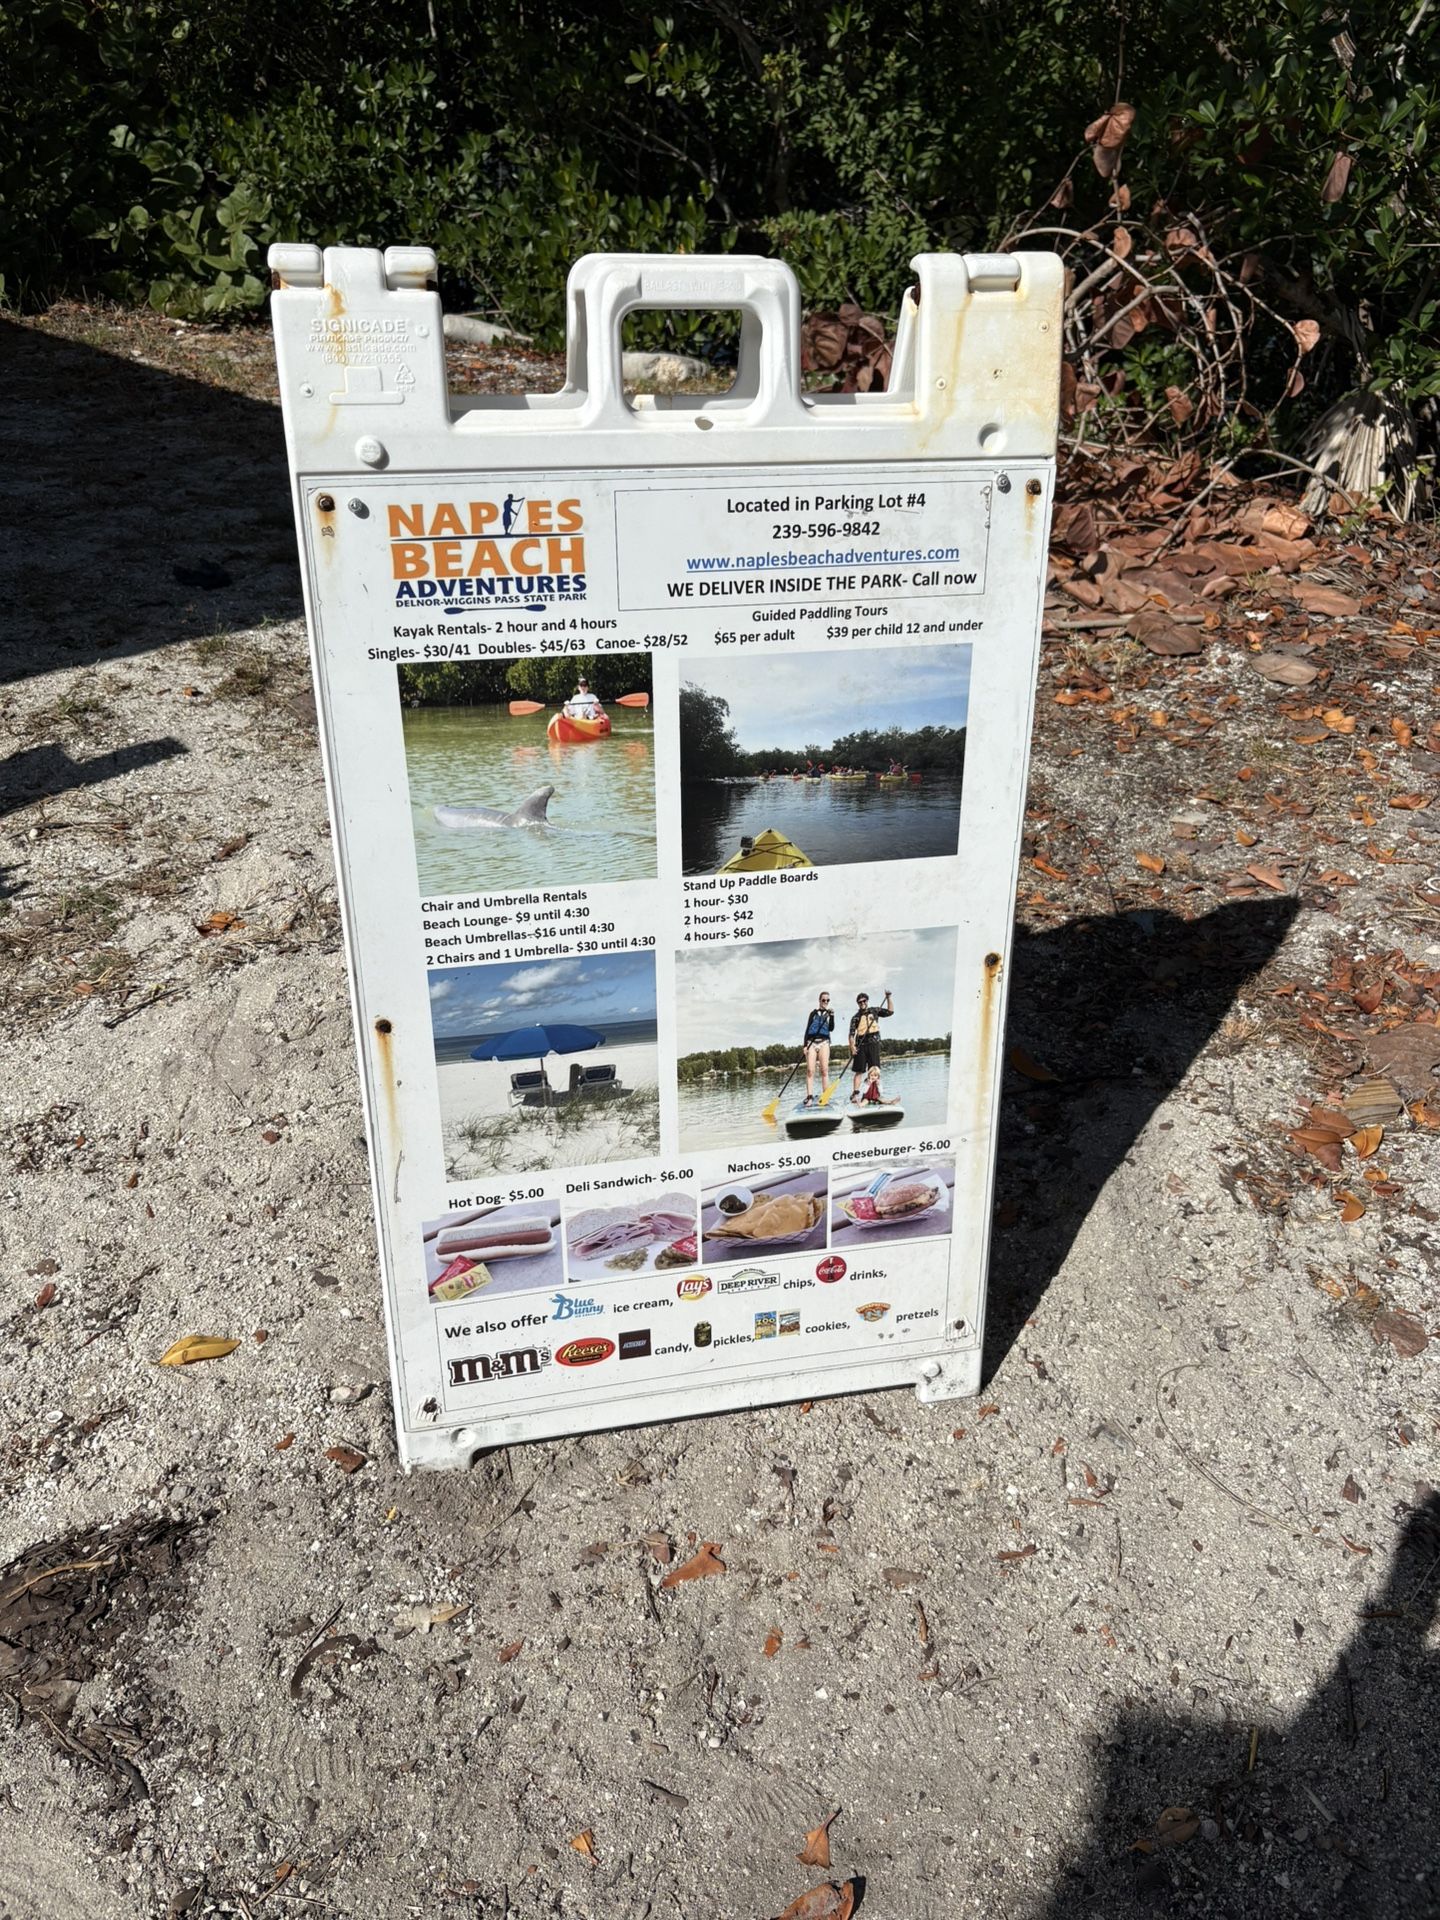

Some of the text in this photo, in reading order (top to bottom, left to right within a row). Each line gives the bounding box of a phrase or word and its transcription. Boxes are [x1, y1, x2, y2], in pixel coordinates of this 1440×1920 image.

[311, 318, 407, 333] SIGNICADE
[727, 493, 926, 514] Located in Parking Lot #4
[387, 494, 584, 537] NAPES
[772, 521, 880, 539] 239-596-9842
[391, 538, 585, 579] BEACH
[686, 547, 960, 571] www.naplesbeachadventures.com
[396, 574, 587, 599] ADVENTURES
[667, 571, 977, 597] WE DELIVER INSIDE THE PARK- Call now
[396, 593, 587, 608] DELNOR-WIGGINS PASS STATE PARK
[752, 605, 888, 622] Guided Paddling Tours
[393, 616, 617, 640] Kayak Rentals- 2 hour and 4 hours
[714, 628, 795, 645] $65 per adult
[826, 619, 983, 640] $39 per child 12 and under
[367, 634, 688, 662] Singles- $30/41 Doubles- $45/63 Canoe- $28/52
[683, 871, 819, 892] Stand Up Paddle Boards
[421, 890, 588, 913] Chair and Umbrella Rentals
[684, 893, 749, 909] 1 hour- $30
[423, 907, 590, 931] Beach Lounge- $9 until 4:30
[684, 910, 754, 926] 2 hours- $42
[425, 934, 462, 948] Beach
[534, 926, 557, 940] $16
[559, 924, 587, 937] until
[589, 922, 615, 934] 4:30
[684, 927, 754, 942] 4 hours- $60
[426, 935, 656, 966] 2 Chairs and 1 Umbrella- $30 until 4:30
[832, 1139, 951, 1162] Cheeseburger- $6.00
[727, 1155, 811, 1174] Nachos- $5.00
[566, 1168, 694, 1194] Deli Sandwich- $6.00
[449, 1187, 544, 1209] Hot Dog- $5.00
[720, 1280, 748, 1293] DEEP
[749, 1276, 778, 1290] RIVER
[783, 1278, 816, 1292] chips,
[850, 1269, 887, 1282] drinks,
[613, 1298, 674, 1314] ice cream,
[896, 1308, 939, 1324] pretzels
[445, 1313, 548, 1339] We also offer
[805, 1320, 850, 1335] cookies,
[654, 1342, 692, 1356] candy,
[713, 1333, 755, 1349] pickles,
